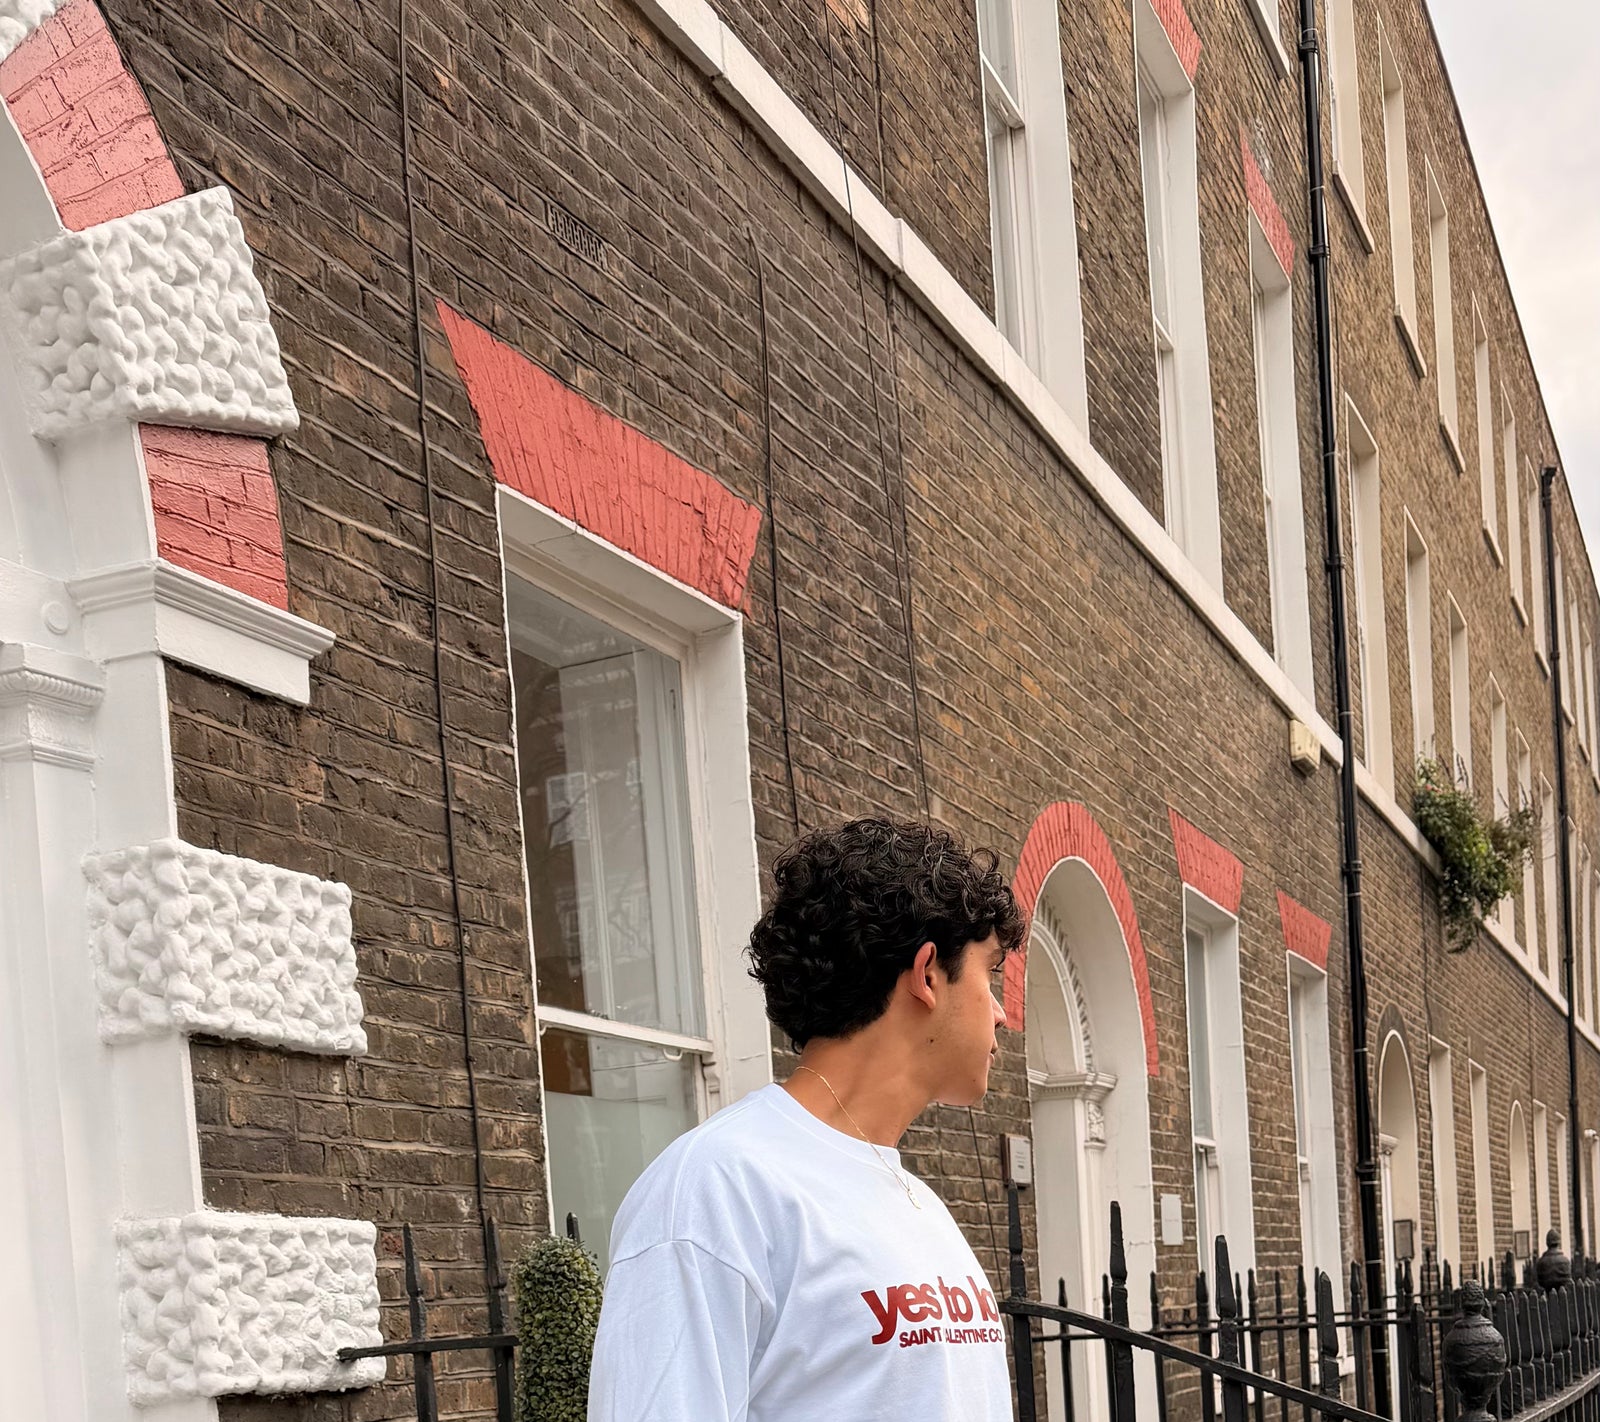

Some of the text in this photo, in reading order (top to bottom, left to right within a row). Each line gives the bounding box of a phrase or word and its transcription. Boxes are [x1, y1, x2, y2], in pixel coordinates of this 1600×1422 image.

[861, 1283, 942, 1344] yes
[937, 1276, 973, 1322] to
[899, 1327, 943, 1348] SAINT
[944, 1328, 988, 1344] ALENTINE
